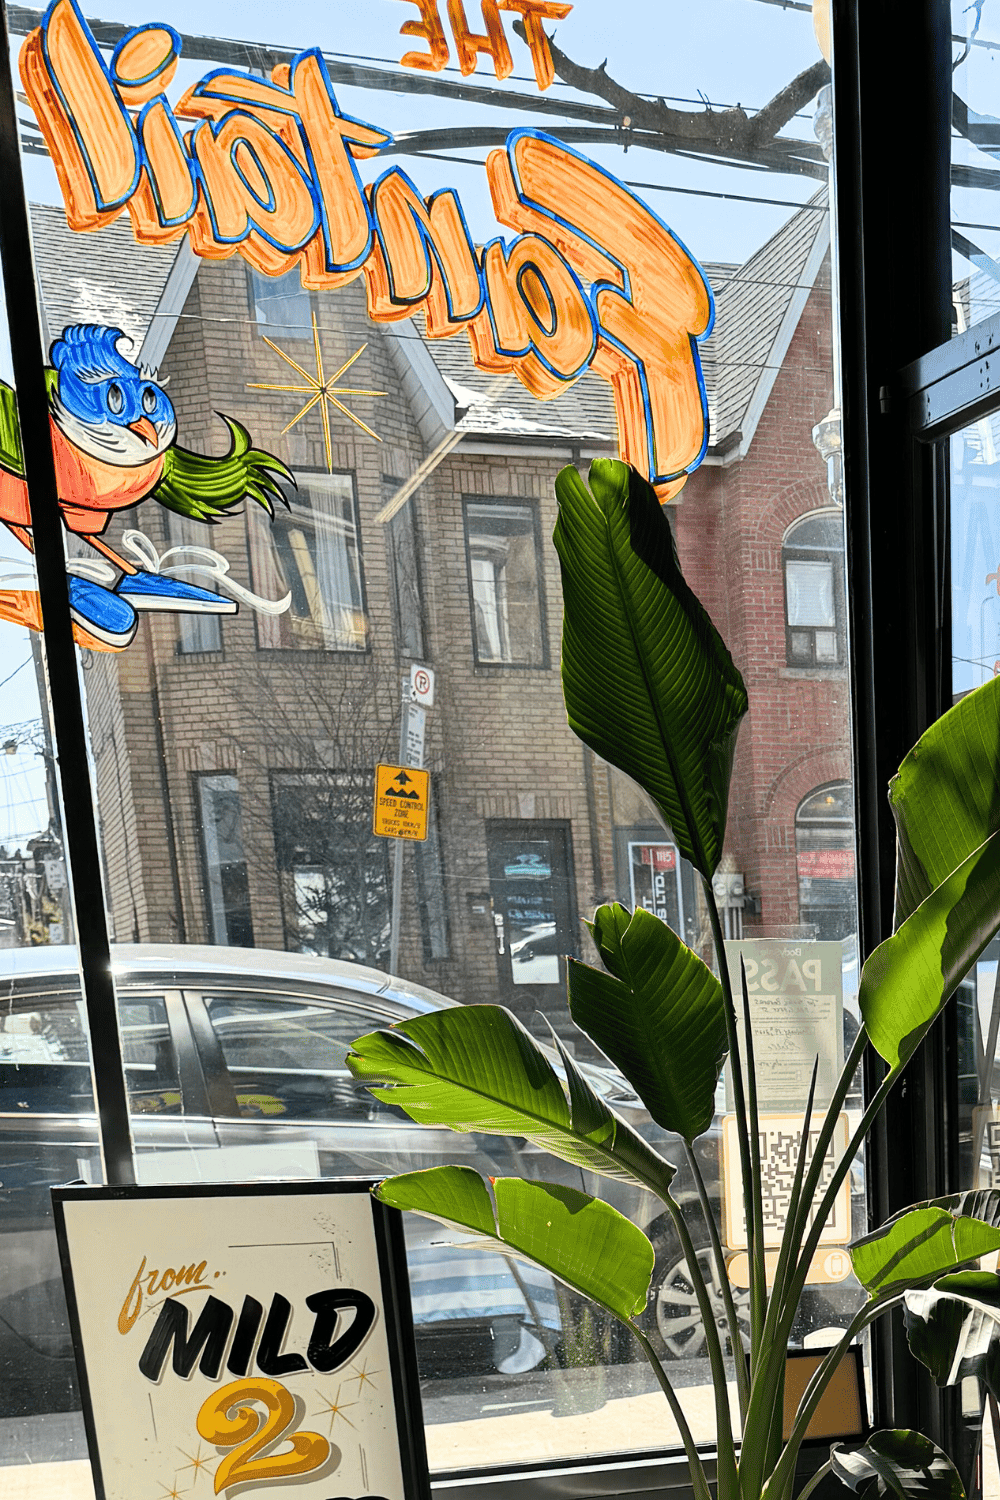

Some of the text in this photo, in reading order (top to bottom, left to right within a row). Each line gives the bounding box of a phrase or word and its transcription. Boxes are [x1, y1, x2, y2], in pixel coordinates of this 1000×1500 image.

[379, 797, 424, 811] SPEED CONTROL
[656, 851, 672, 862] 1115
[655, 872, 666, 904] LTD.
[139, 1288, 379, 1386] MILD
